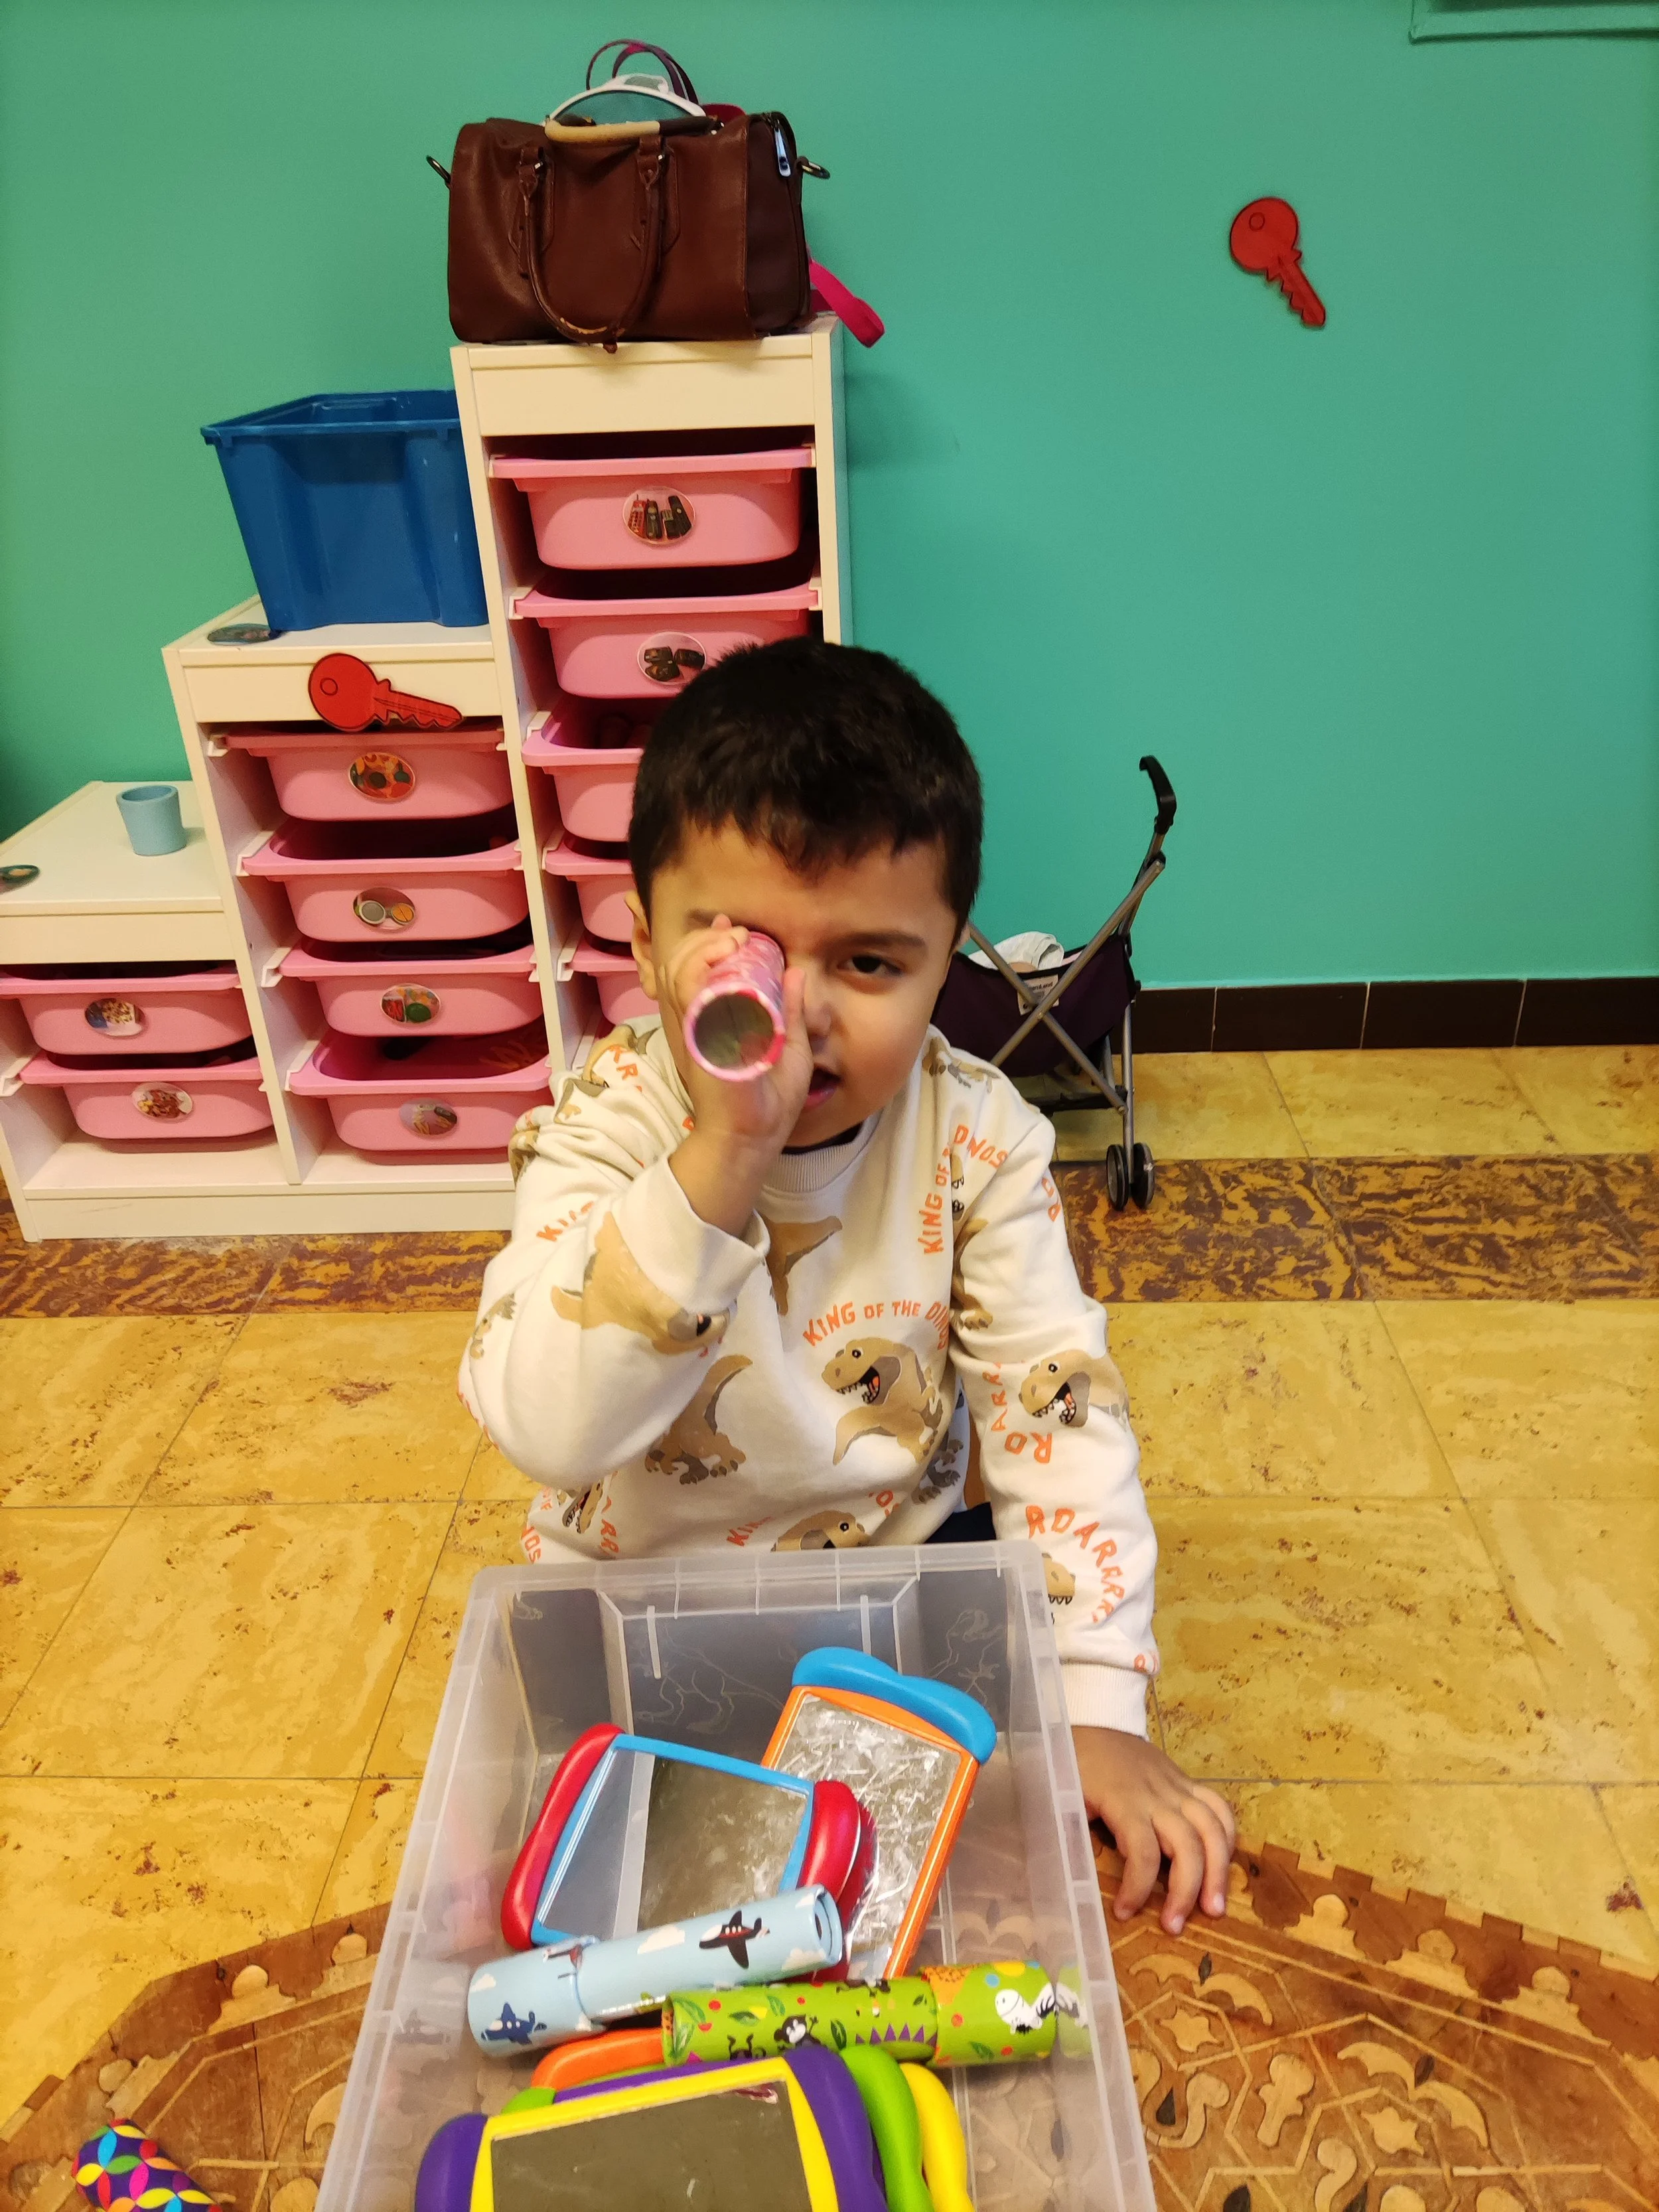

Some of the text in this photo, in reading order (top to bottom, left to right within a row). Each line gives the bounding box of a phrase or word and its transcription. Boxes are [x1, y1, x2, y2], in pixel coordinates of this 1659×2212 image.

[917, 1193, 944, 1255] KING
[802, 1301, 856, 1347] KING
[863, 1303, 885, 1319] OF
[892, 1299, 922, 1317] THE
